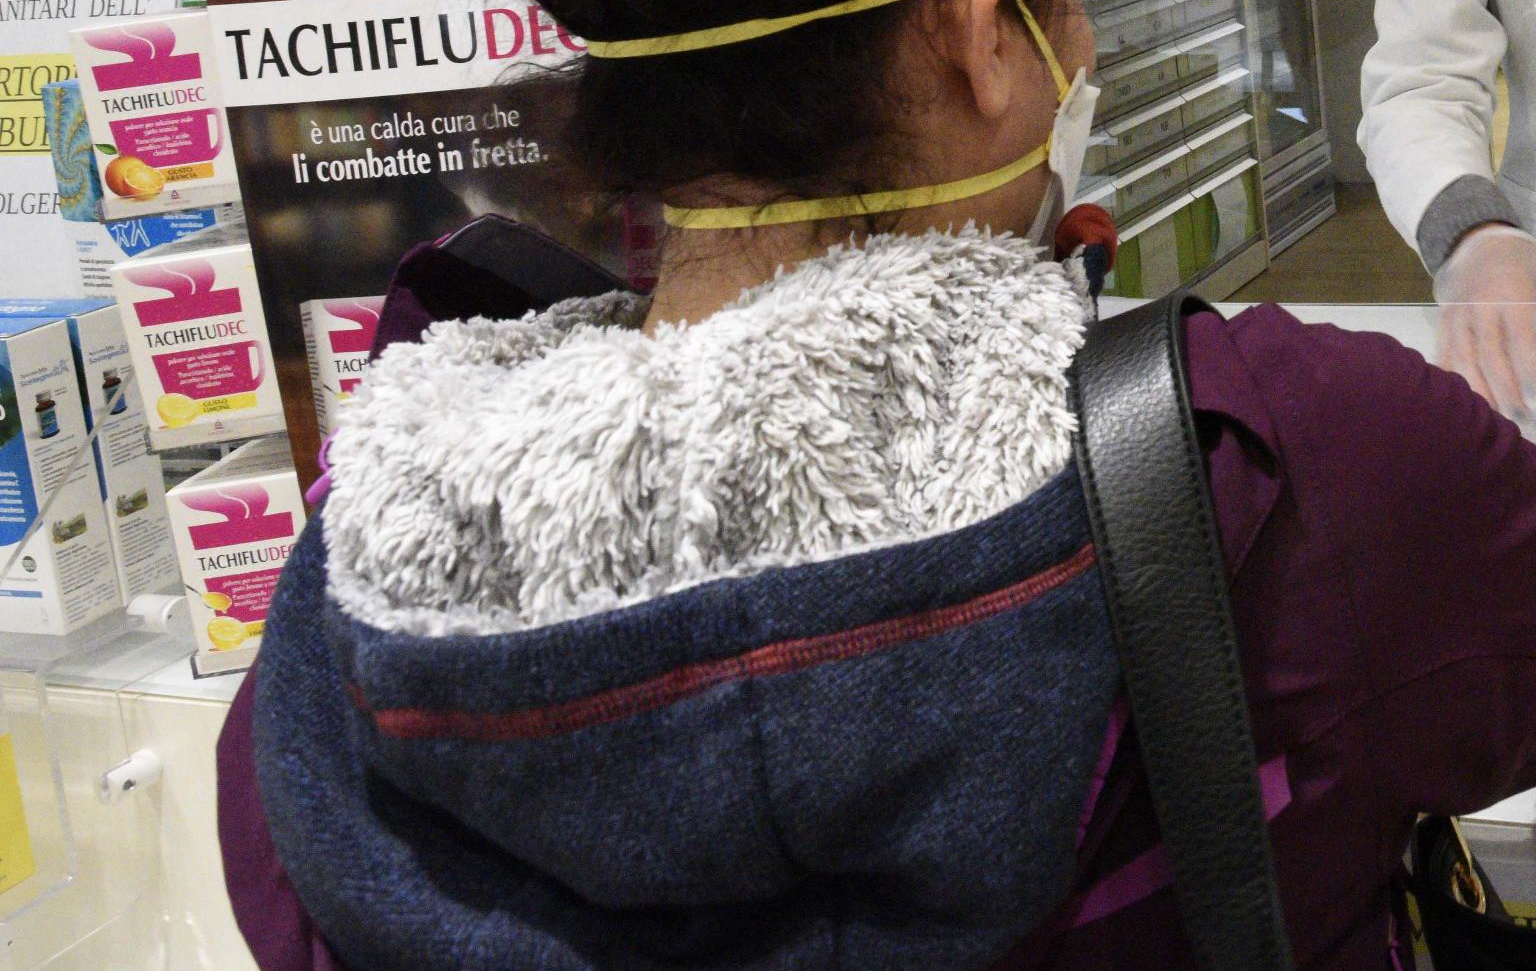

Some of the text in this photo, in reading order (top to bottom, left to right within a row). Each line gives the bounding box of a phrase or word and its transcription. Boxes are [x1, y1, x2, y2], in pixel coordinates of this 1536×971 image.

[0, 65, 77, 97] RTOP
[102, 86, 207, 114] TACHIFLUDEC
[311, 103, 521, 145] è una calda cura che
[292, 137, 549, 184] li combatte in fretta.
[144, 319, 248, 349] TACHIFLUDEC
